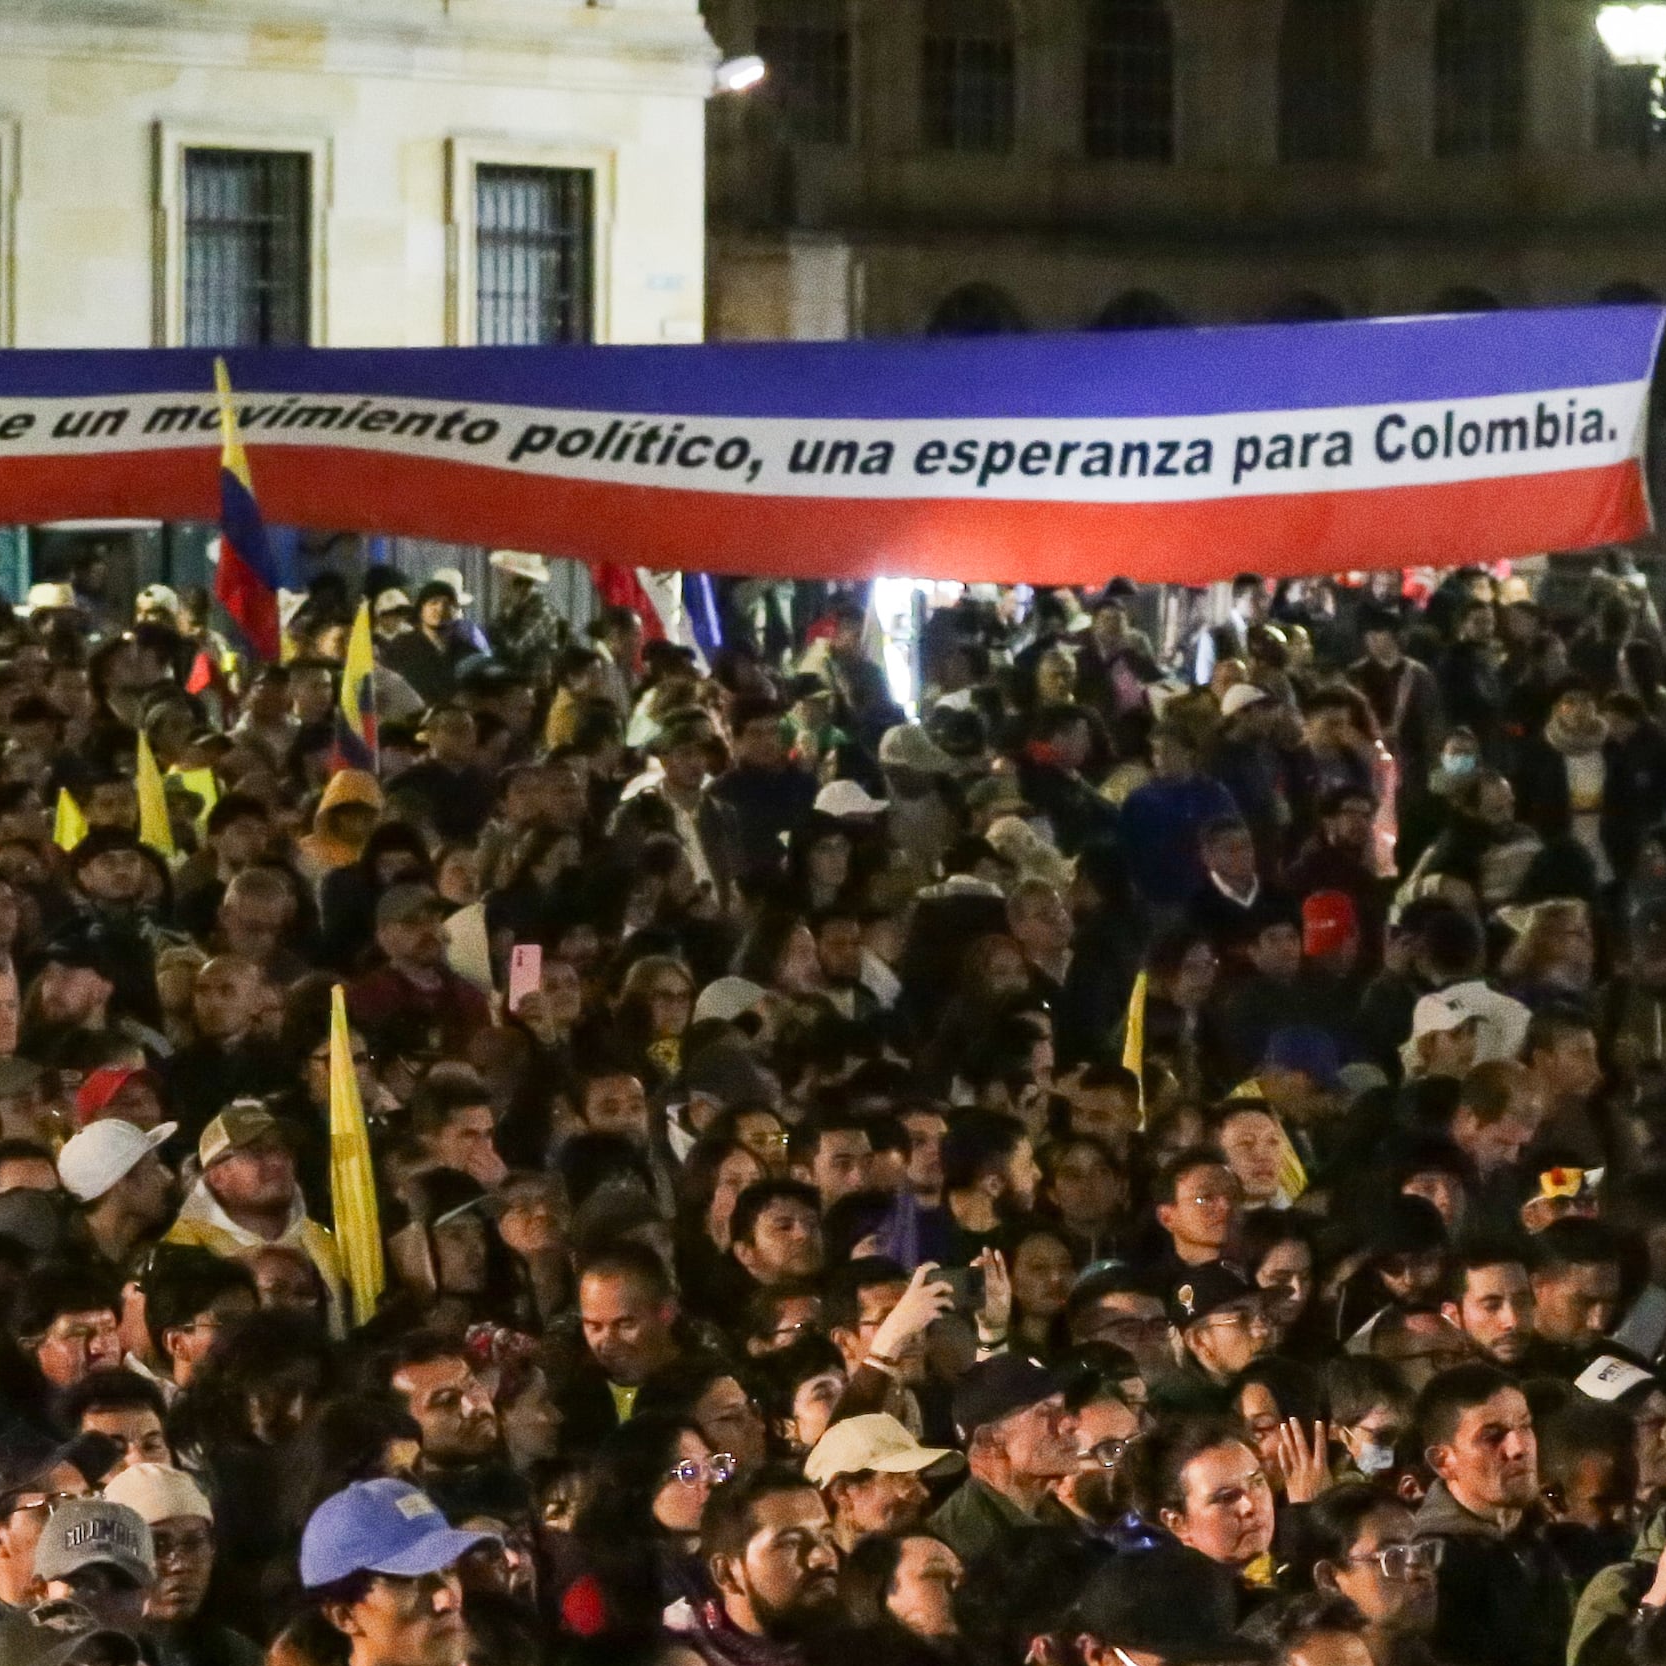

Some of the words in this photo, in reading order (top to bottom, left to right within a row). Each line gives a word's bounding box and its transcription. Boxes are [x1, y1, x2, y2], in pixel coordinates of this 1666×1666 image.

[51, 409, 130, 438] un
[141, 397, 500, 445] movimiento
[507, 419, 763, 483] político,
[787, 438, 895, 475] una
[913, 438, 1214, 487] esperanza
[1232, 430, 1353, 485] para
[1375, 398, 1617, 463] Colombia.
